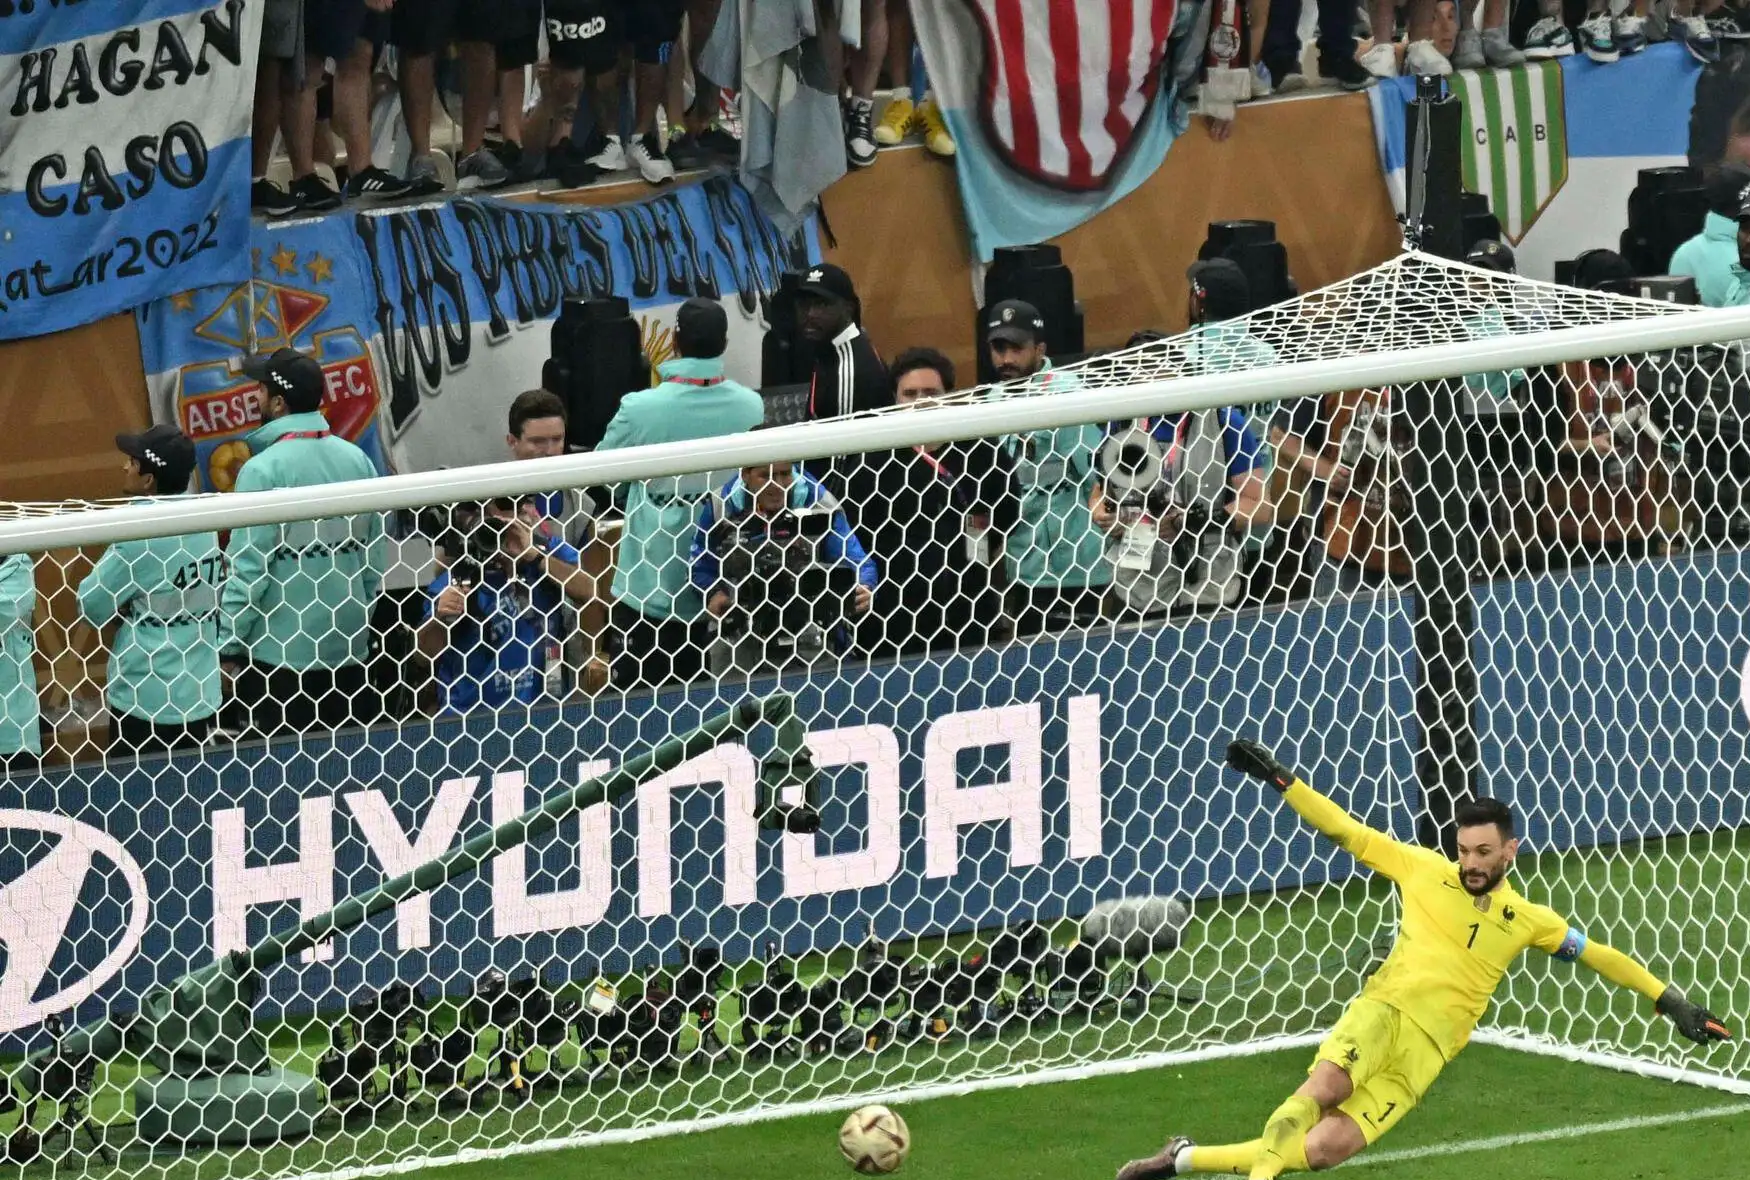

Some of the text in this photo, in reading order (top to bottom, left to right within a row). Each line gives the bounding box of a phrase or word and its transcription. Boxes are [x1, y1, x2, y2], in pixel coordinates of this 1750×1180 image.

[10, 0, 245, 116] HAGAN
[26, 121, 208, 217] CASO
[0, 210, 219, 312] atar2022
[211, 693, 1101, 962] HYUNDAI
[1466, 922, 1480, 949] 1
[1378, 1102, 1396, 1122] 1
